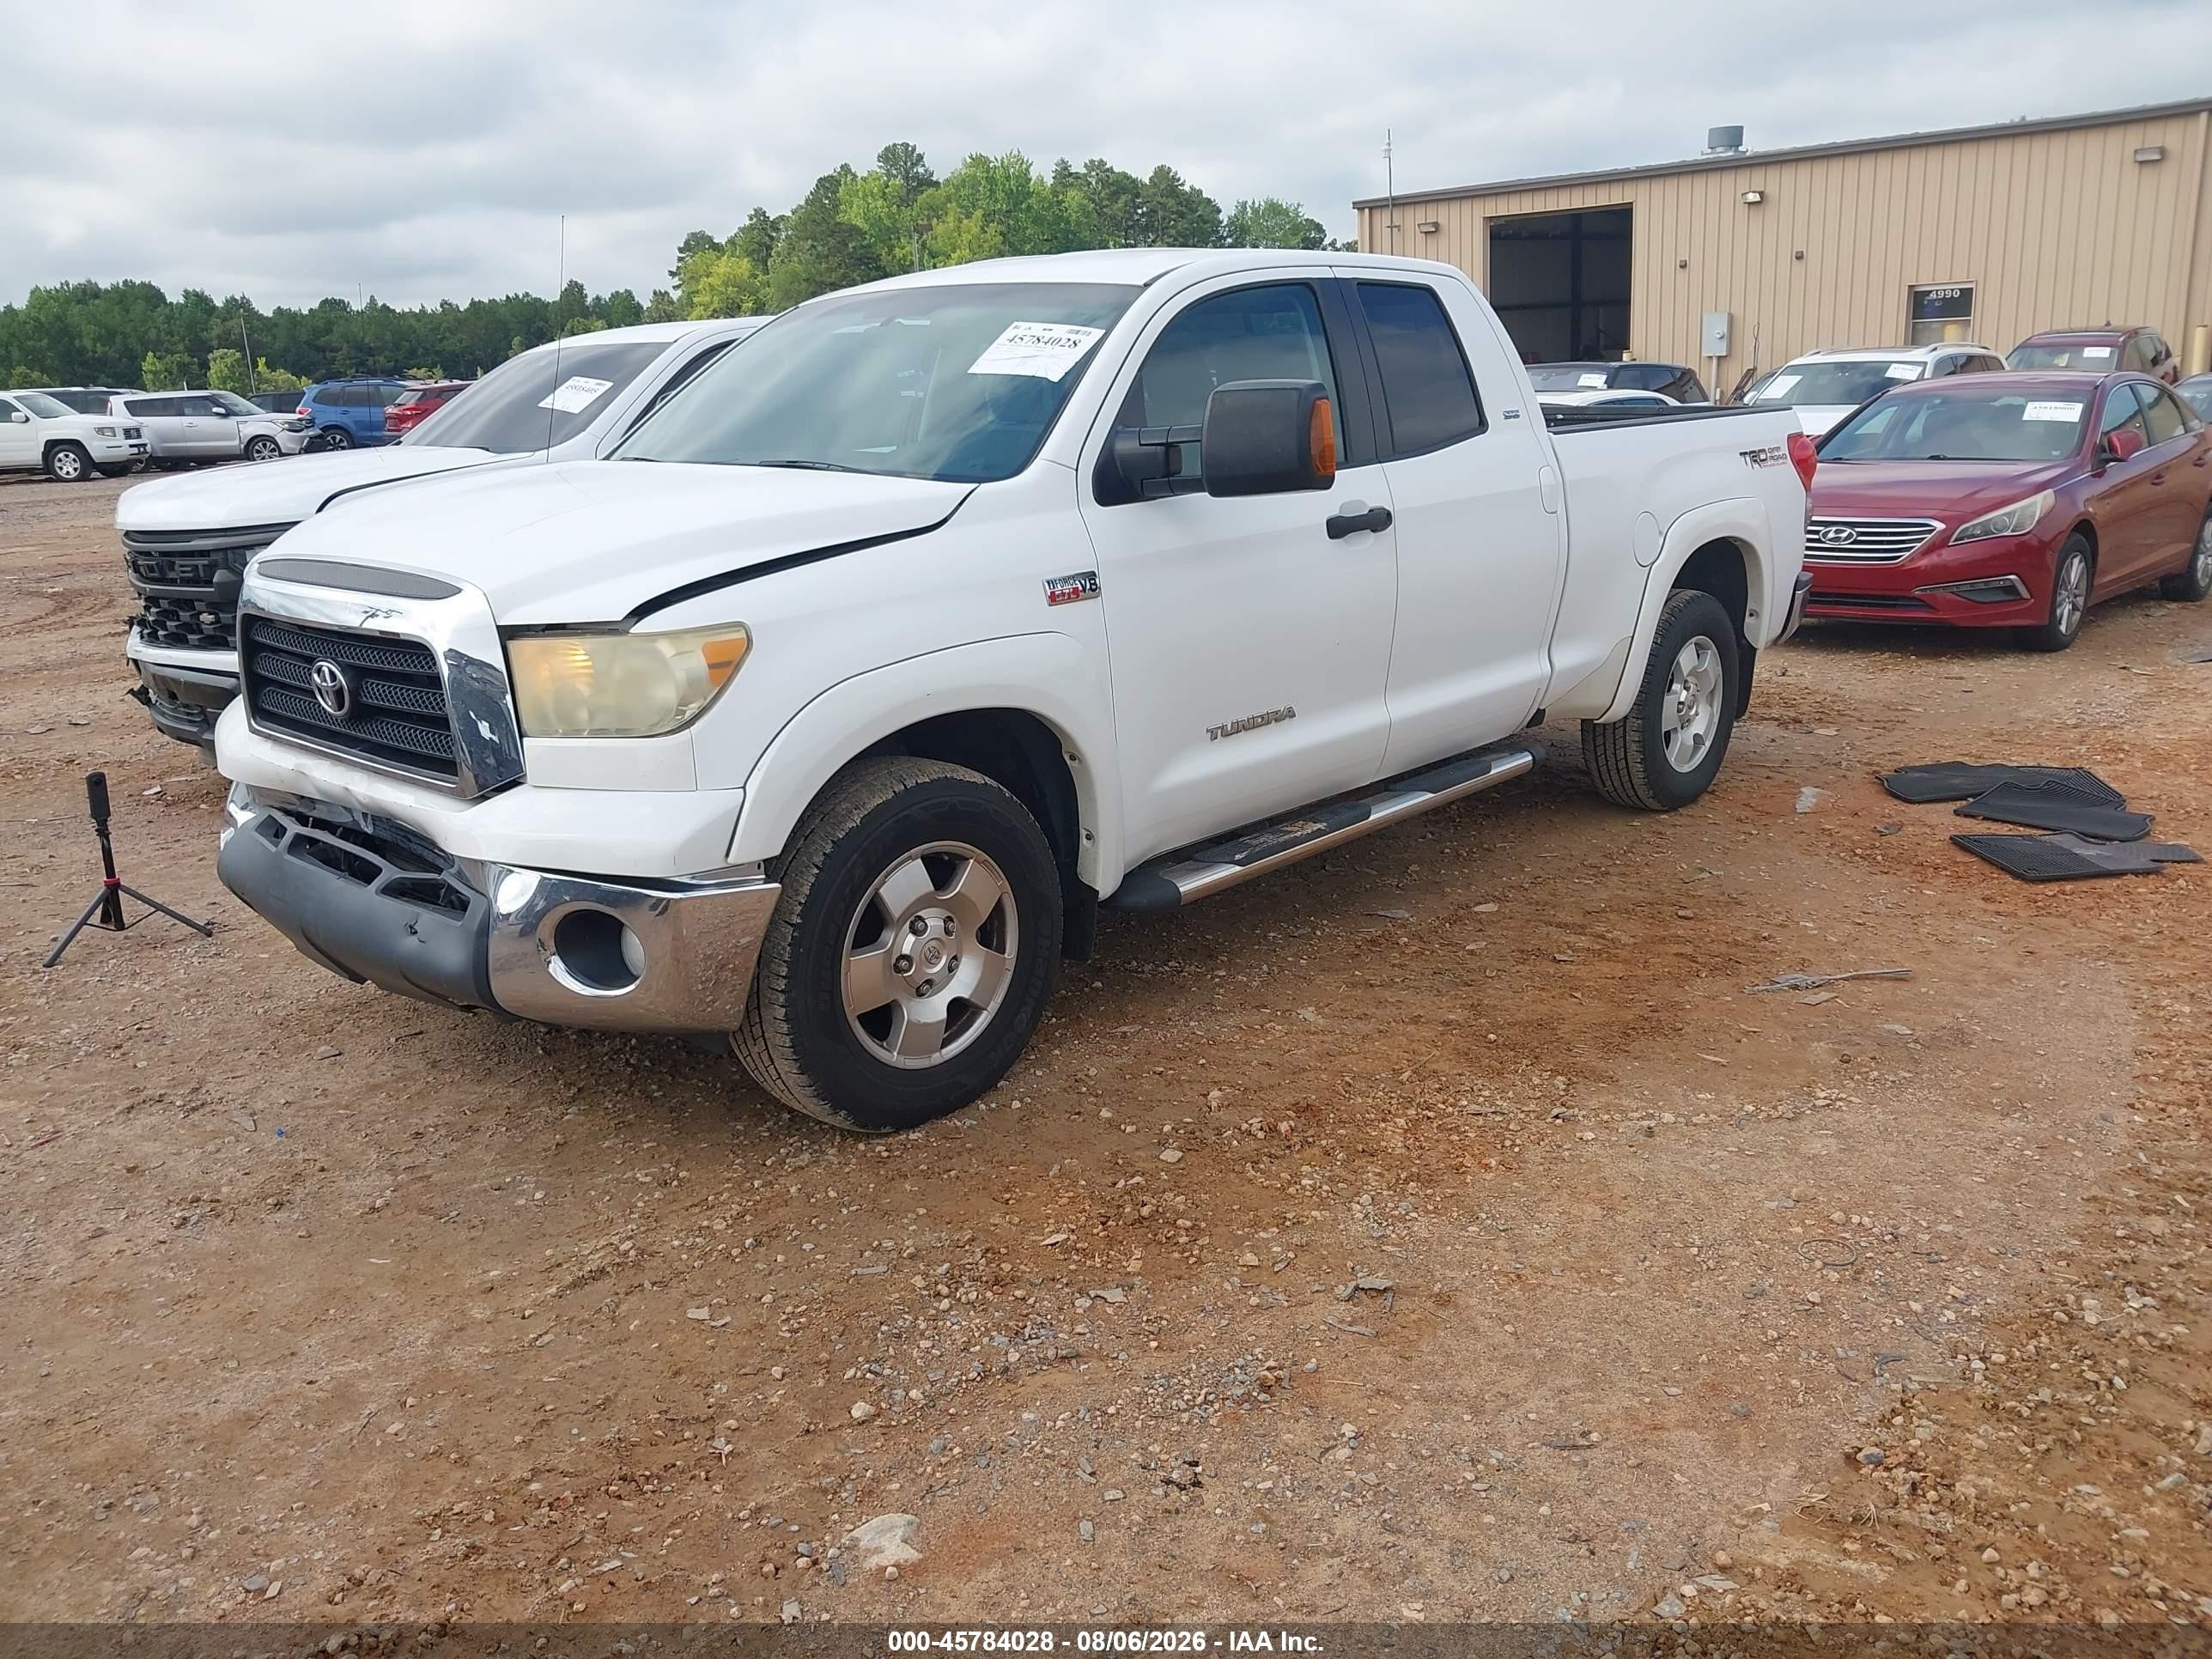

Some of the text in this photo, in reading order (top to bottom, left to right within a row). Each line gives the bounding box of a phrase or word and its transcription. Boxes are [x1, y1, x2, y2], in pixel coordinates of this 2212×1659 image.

[1929, 289, 1960, 299] 4990
[1006, 334, 1082, 349] 45784028
[1739, 448, 1767, 470] TRD
[1769, 453, 1787, 462] ROAD
[1079, 577, 1098, 593] V8
[1206, 704, 1297, 741] TUNDRA
